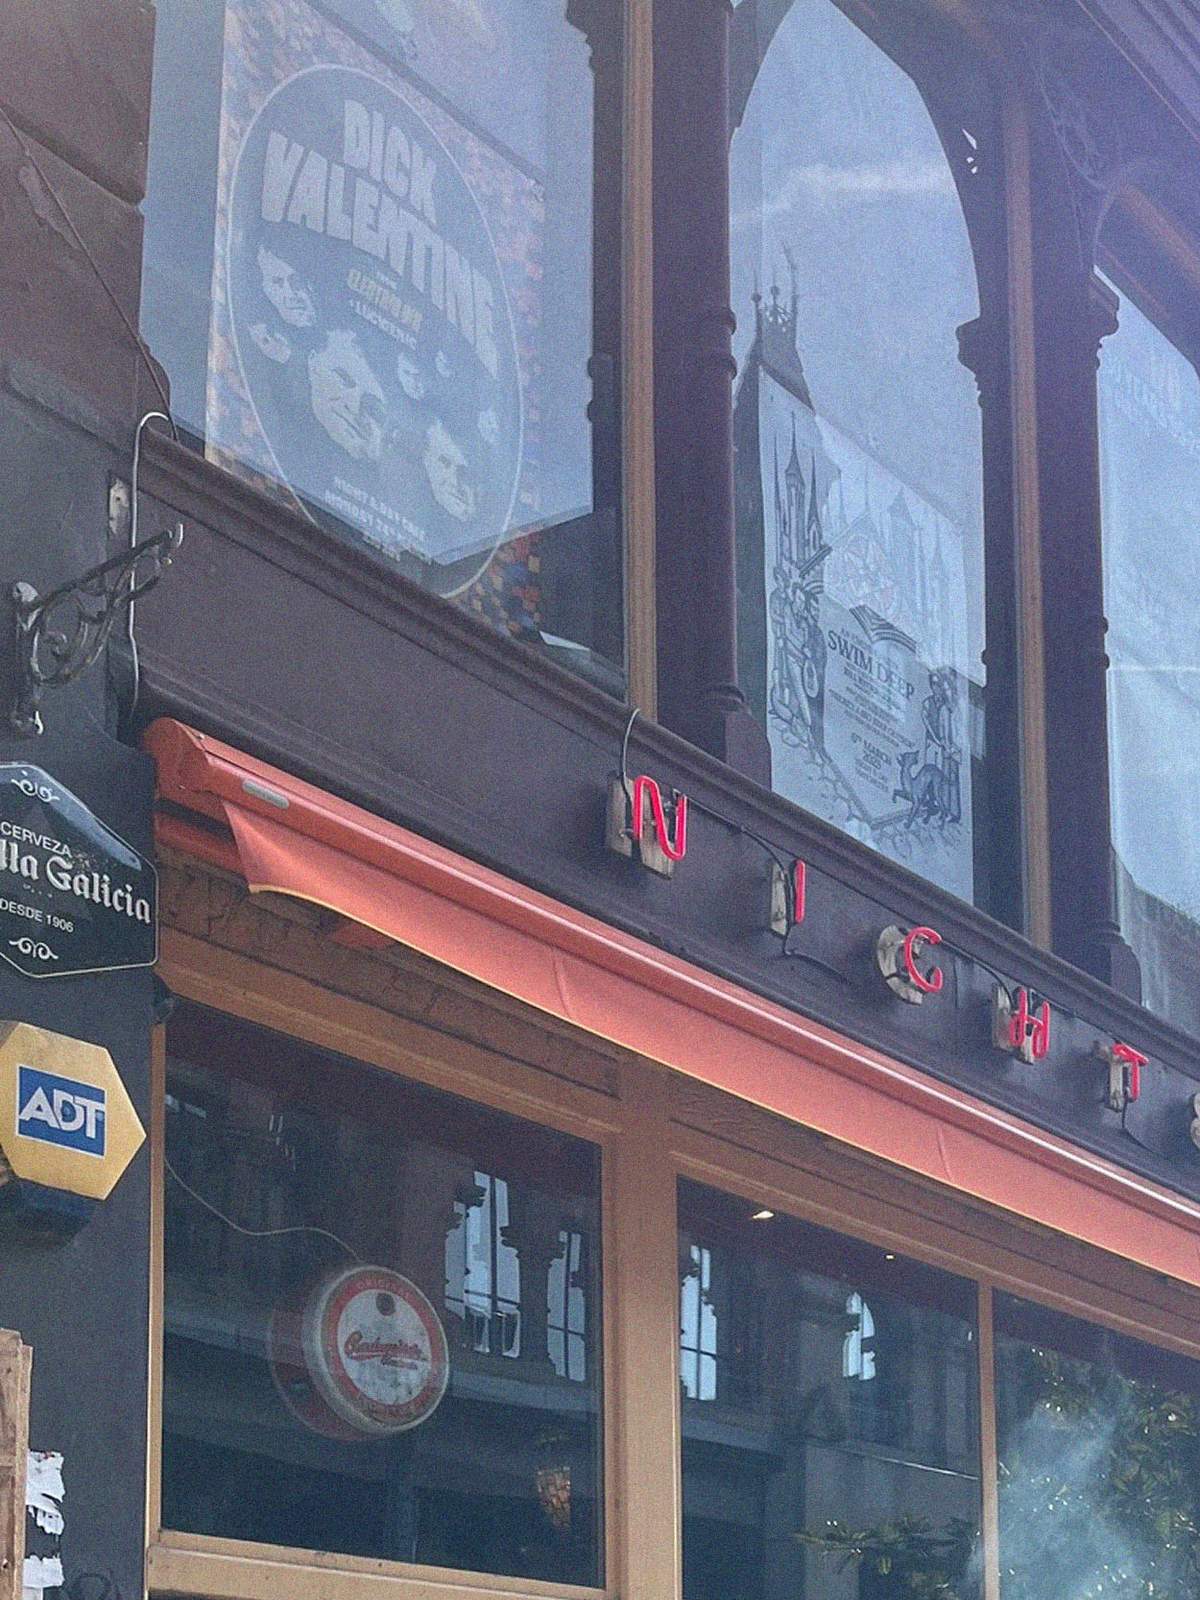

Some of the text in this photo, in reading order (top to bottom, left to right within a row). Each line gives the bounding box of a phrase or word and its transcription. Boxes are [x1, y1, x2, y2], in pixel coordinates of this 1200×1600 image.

[344, 99, 437, 226] DICK
[261, 129, 498, 382] VALENTINE
[828, 630, 872, 674] SWIM
[0, 820, 73, 858] CERVEZA
[0, 897, 74, 933] DESDE 1906
[45, 855, 151, 924] Galicia
[19, 1086, 106, 1139] ADT
